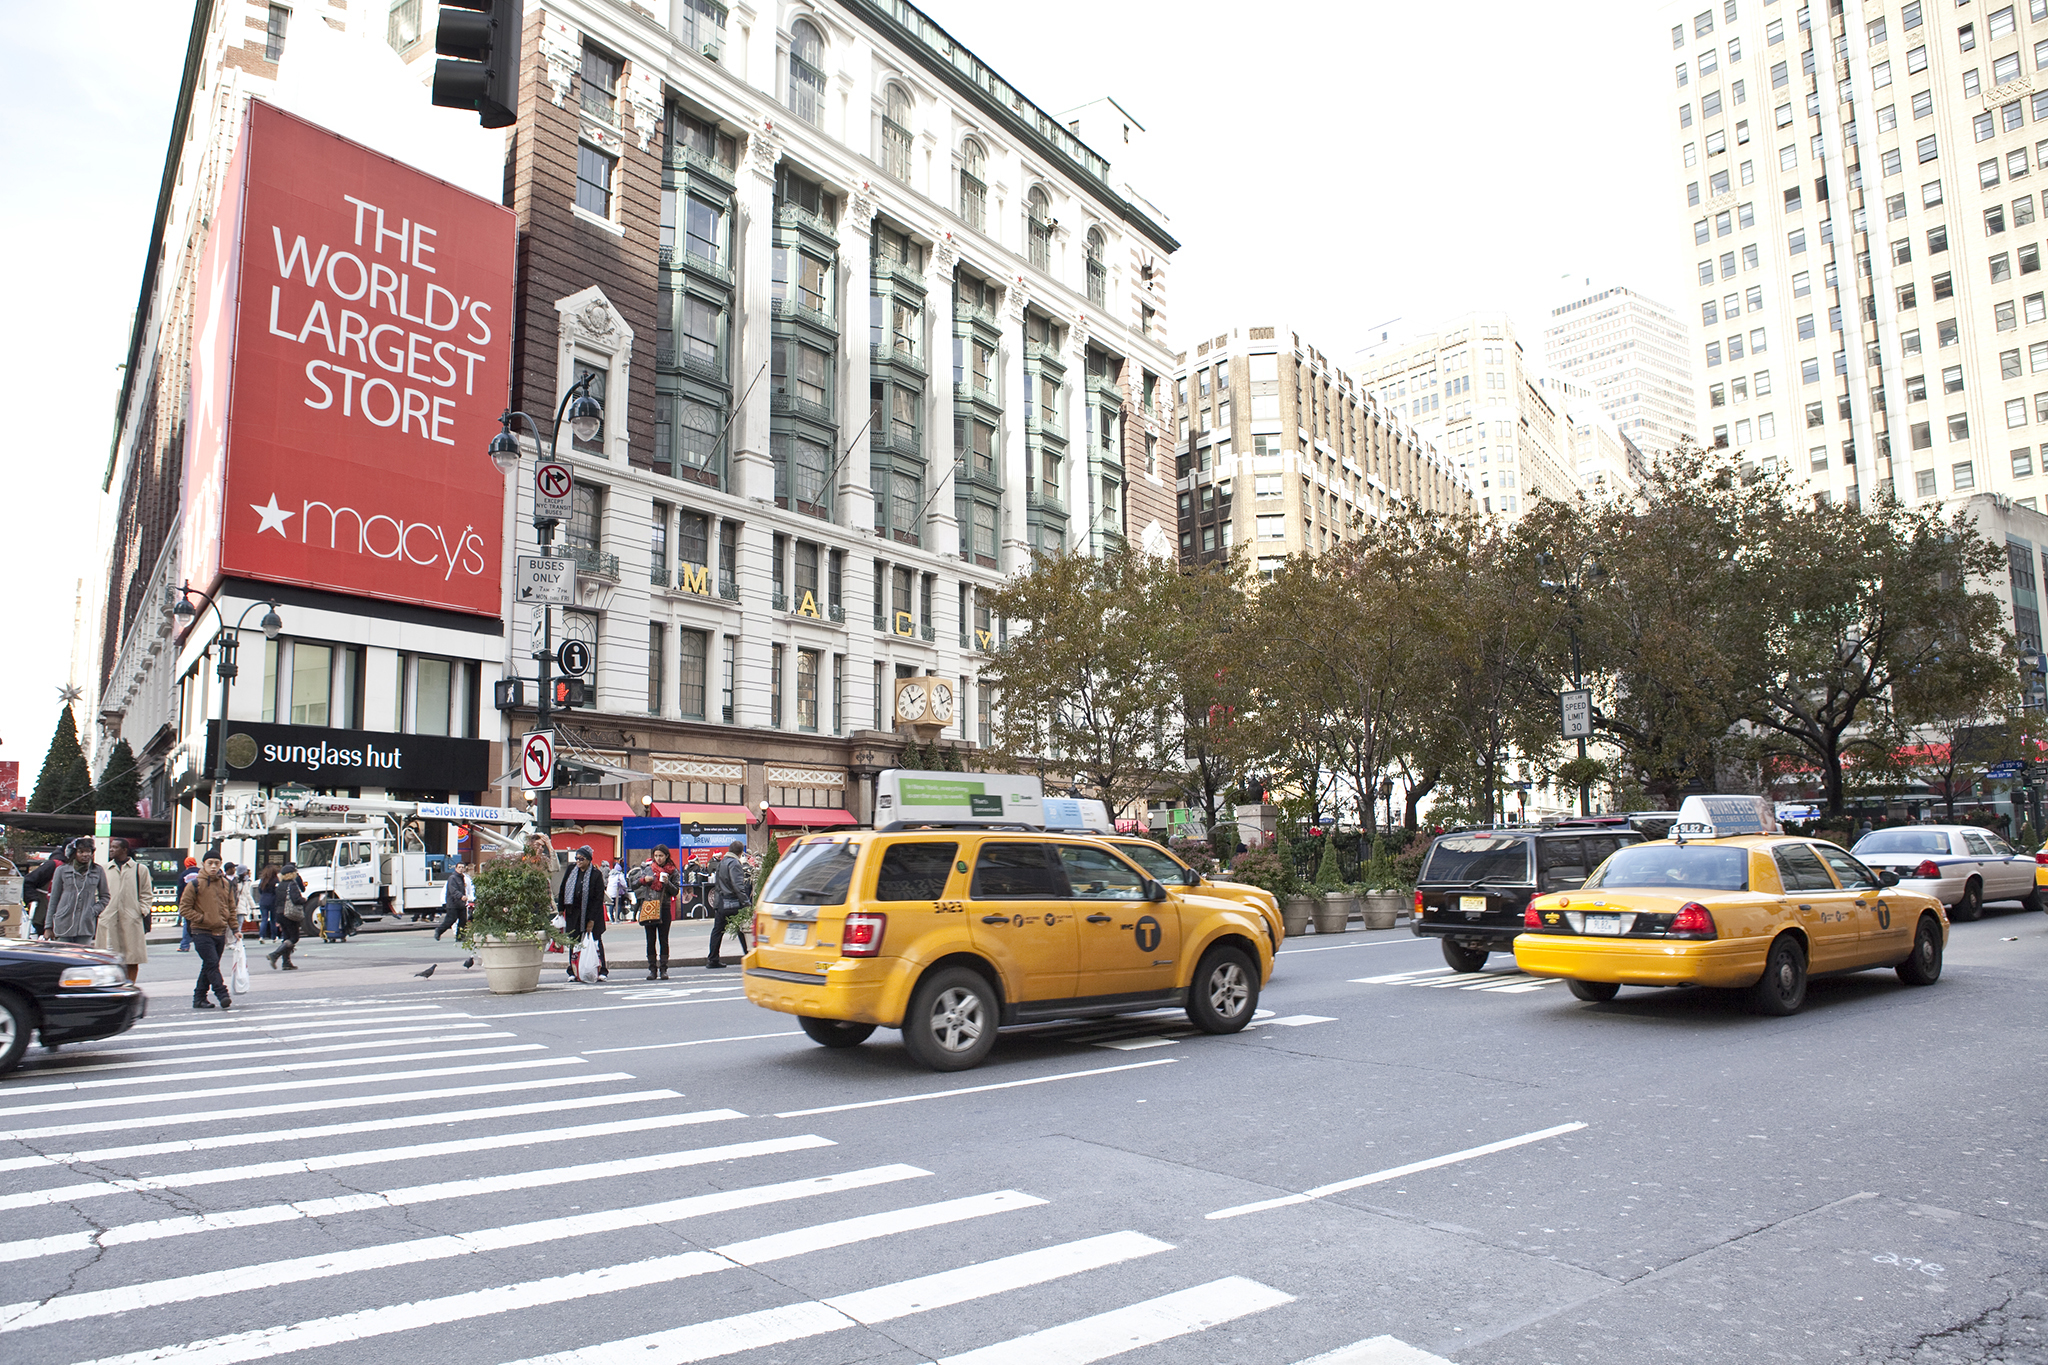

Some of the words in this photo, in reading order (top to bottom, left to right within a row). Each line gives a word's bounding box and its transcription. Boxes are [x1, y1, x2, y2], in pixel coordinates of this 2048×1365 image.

[344, 194, 437, 273] THE
[272, 225, 492, 346] WORLD'S
[269, 285, 486, 396] LARGEST
[303, 359, 456, 446] STORE
[302, 499, 485, 582] macy's
[529, 559, 565, 571] BUSES
[532, 572, 561, 583] ONLY
[681, 562, 709, 596] M
[797, 590, 820, 618] A
[895, 611, 912, 636] C
[976, 630, 993, 650] Y
[1565, 702, 1587, 711] SPEED
[1567, 712, 1584, 721] LIMIT
[1571, 722, 1582, 732] 30
[263, 741, 362, 771] sunglass
[366, 744, 402, 769] hut
[435, 806, 457, 816] SIGN
[459, 807, 499, 819] SERVICES
[1680, 824, 1700, 833] 9L82
[1140, 923, 1156, 948] T
